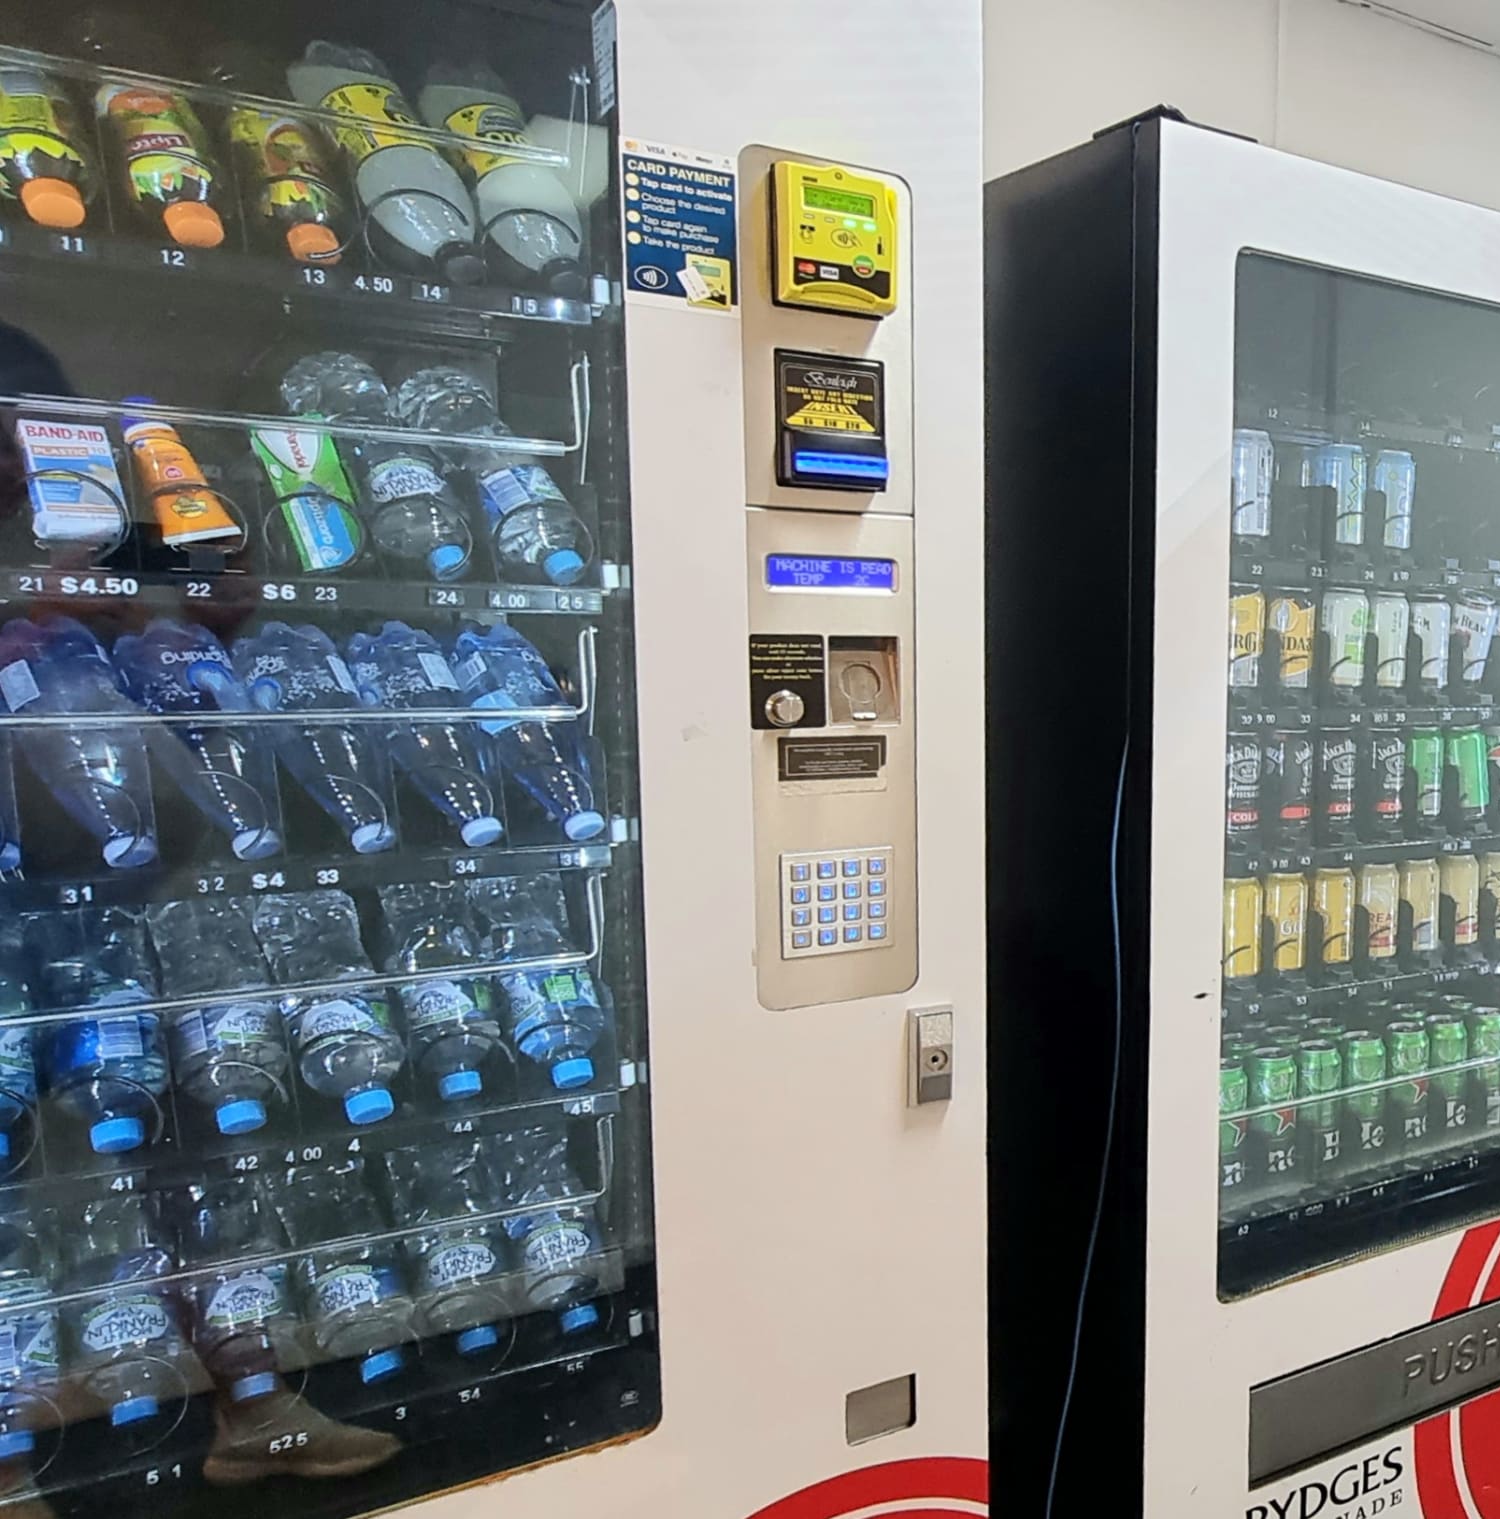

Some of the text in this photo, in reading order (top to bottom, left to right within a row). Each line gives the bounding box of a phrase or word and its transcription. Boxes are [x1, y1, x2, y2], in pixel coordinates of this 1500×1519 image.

[627, 159, 731, 187] CARD PAYMENT
[641, 177, 659, 189] Tap
[661, 182, 682, 192] card
[60, 235, 84, 252] 11
[160, 249, 185, 267] 12
[303, 268, 325, 286] 13
[421, 283, 442, 300] 14
[776, 559, 832, 573] MACHINE
[840, 562, 855, 574] IS
[19, 577, 42, 592] 21
[61, 578, 138, 594] $4.50
[187, 583, 212, 597] 22
[263, 584, 296, 600] $6
[315, 587, 337, 600] 23
[437, 591, 458, 605] 24
[252, 873, 285, 888] $4
[317, 869, 339, 884] 33
[455, 861, 476, 874] 34
[235, 1156, 258, 1171] 42
[454, 1121, 473, 1133] 44
